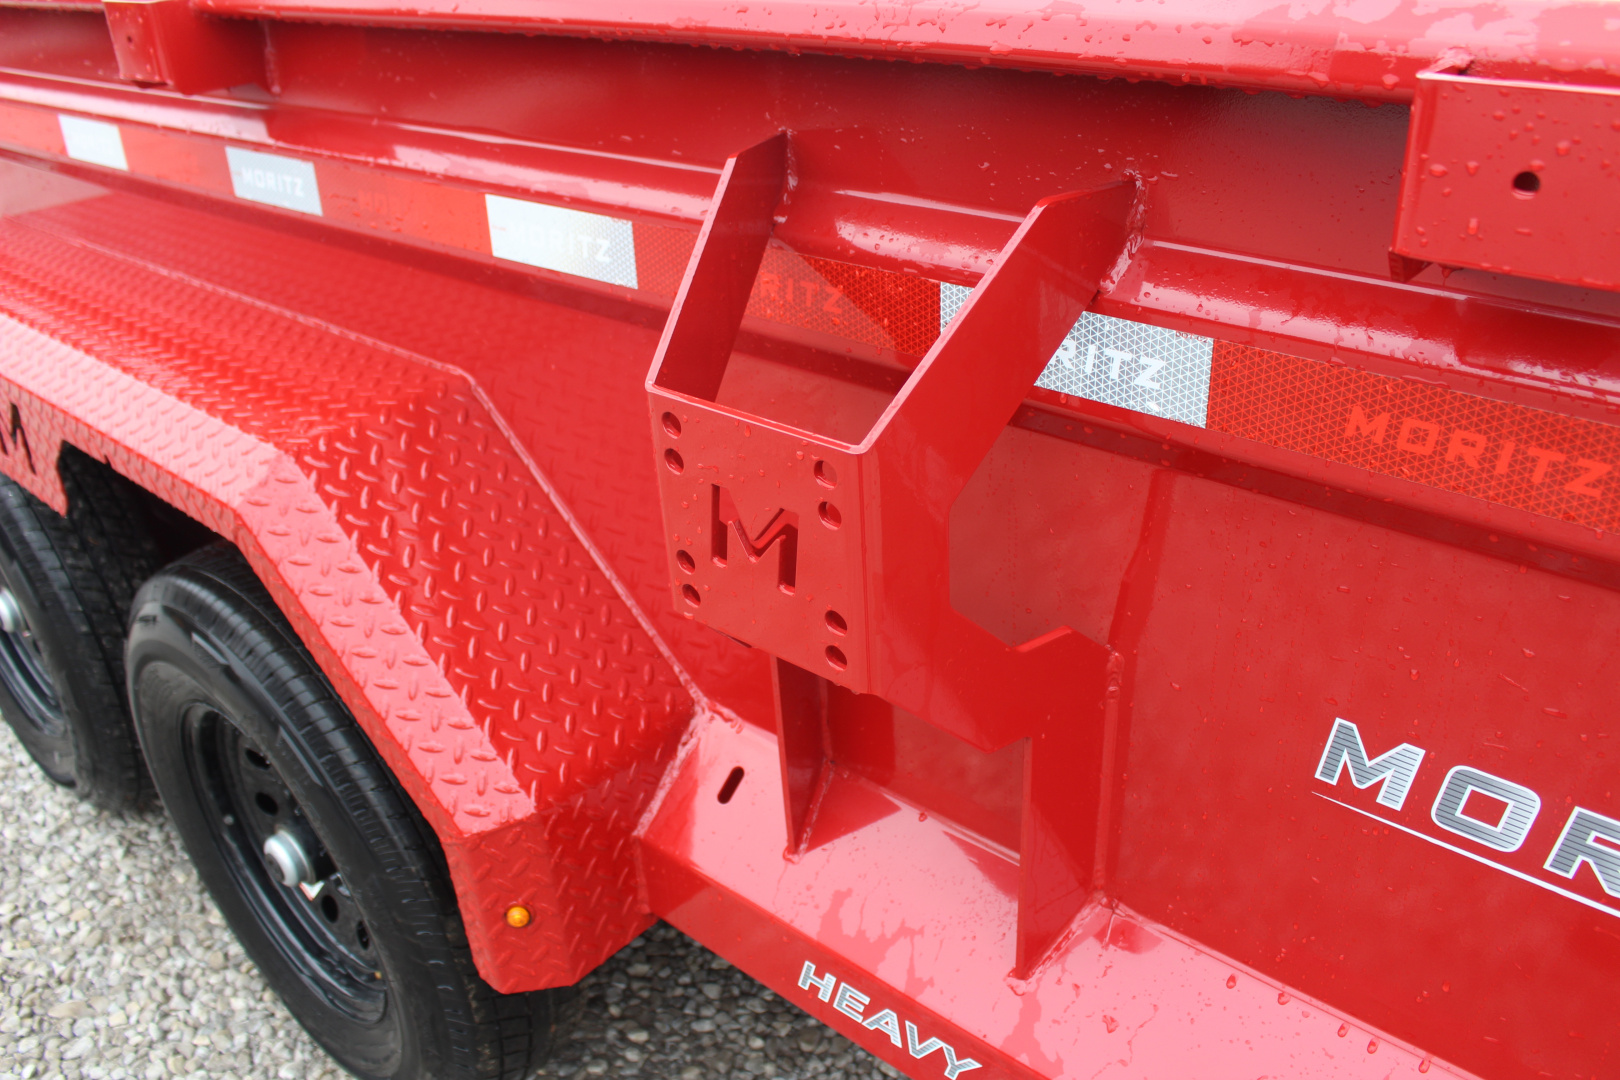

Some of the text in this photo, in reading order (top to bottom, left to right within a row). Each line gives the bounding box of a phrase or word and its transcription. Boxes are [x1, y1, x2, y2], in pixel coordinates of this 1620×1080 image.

[241, 166, 305, 198] MORITZ
[508, 220, 611, 264] MORITZ
[1344, 405, 1614, 497] MORITZ
[711, 483, 799, 597] M
[1314, 717, 1620, 898] MOR
[798, 960, 983, 1080] HEAVY
